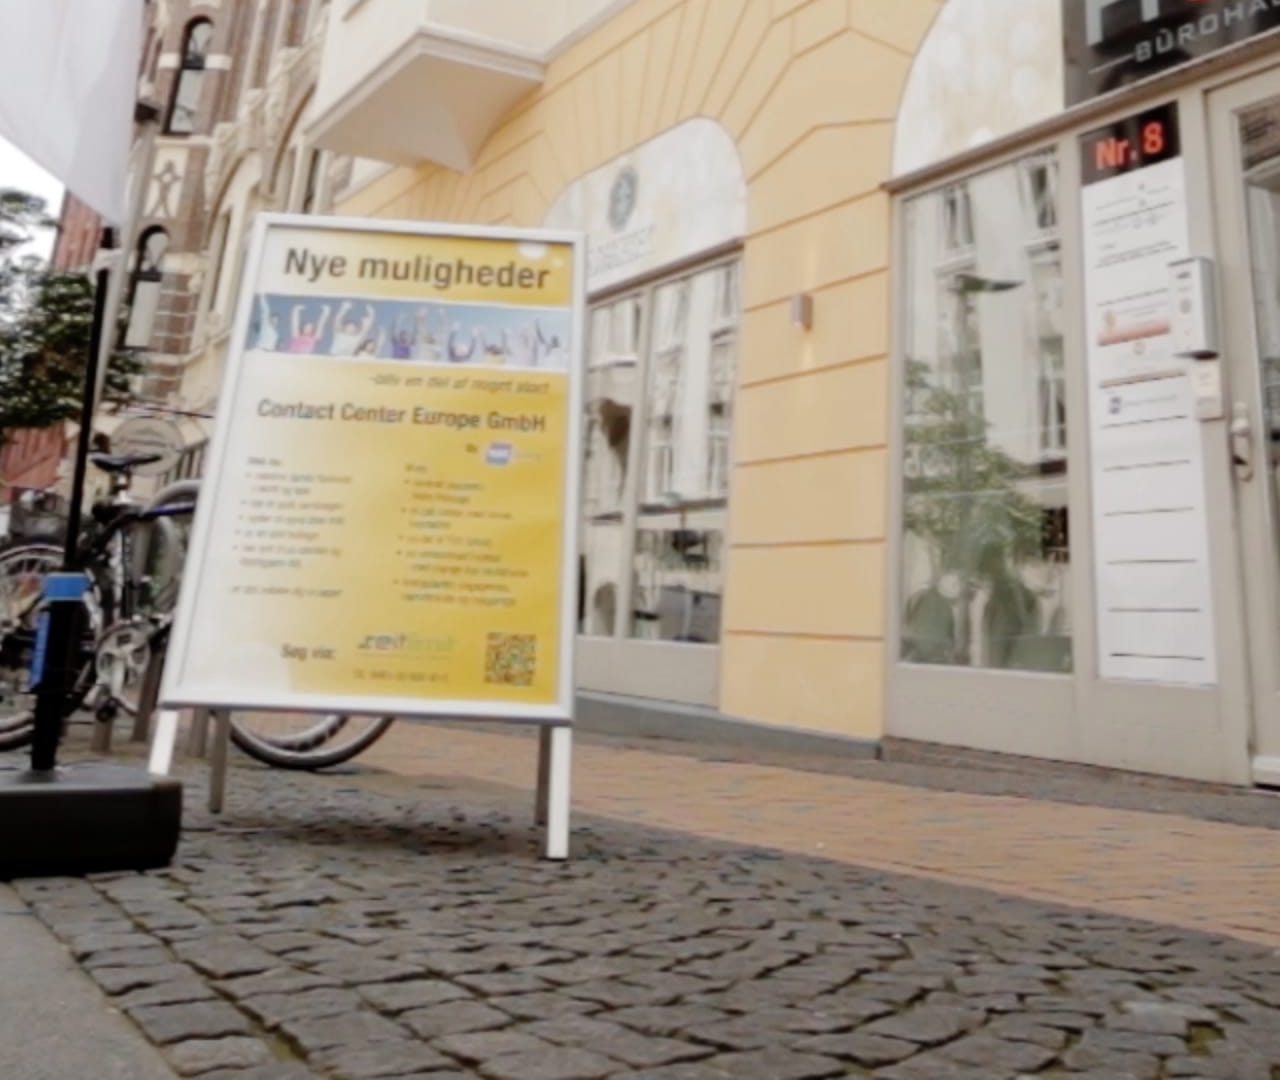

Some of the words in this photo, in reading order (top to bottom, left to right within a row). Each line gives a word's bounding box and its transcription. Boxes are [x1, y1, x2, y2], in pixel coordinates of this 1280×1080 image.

[1094, 137, 1138, 170] Nr.
[1142, 121, 1165, 155] 8
[284, 248, 347, 282] Nye
[358, 254, 551, 290] muligheder
[257, 397, 335, 420] Contact
[341, 402, 407, 424] Center
[412, 406, 481, 431] Europe
[487, 410, 547, 434] GmbH
